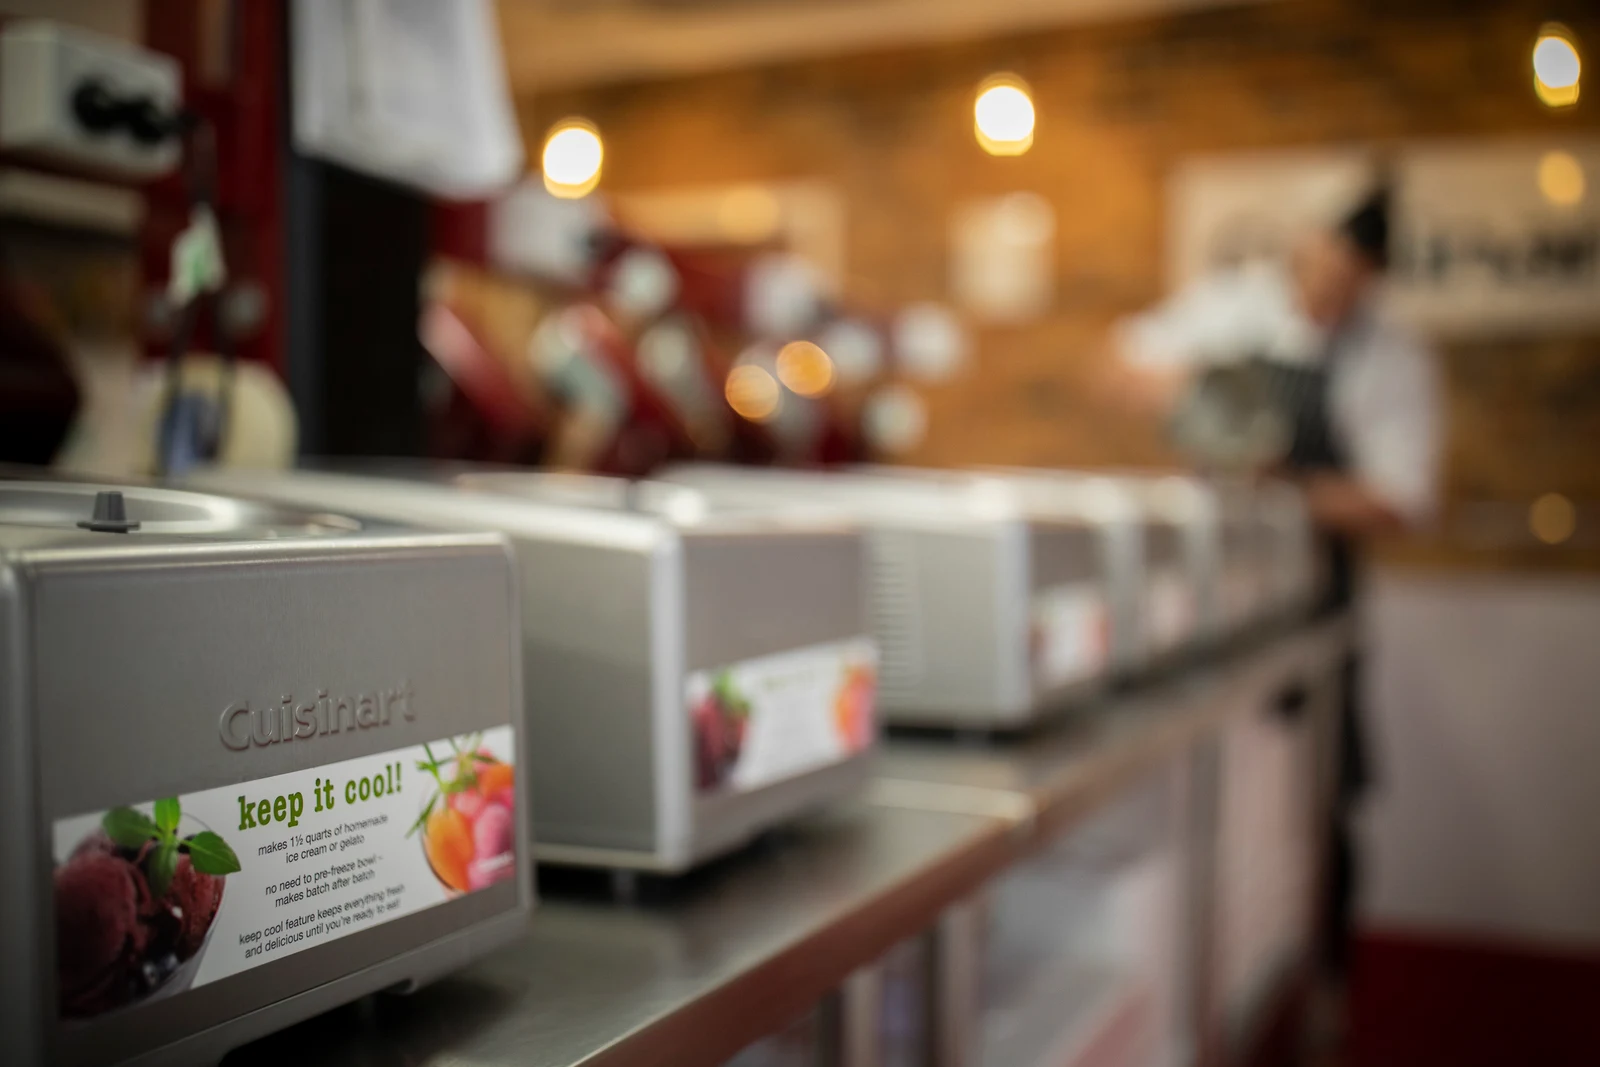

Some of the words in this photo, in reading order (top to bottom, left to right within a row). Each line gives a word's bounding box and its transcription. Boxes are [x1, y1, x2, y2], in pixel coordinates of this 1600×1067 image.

[219, 681, 415, 752] Cuisinart
[238, 792, 303, 830] keep
[314, 778, 335, 812] it
[345, 761, 401, 804] cool!
[258, 840, 288, 856] makes
[305, 828, 332, 846] quarts
[334, 823, 343, 836] of
[344, 814, 388, 832] homemade
[286, 852, 299, 863] ice
[301, 844, 327, 860] cream
[329, 841, 338, 851] or
[340, 834, 365, 851] gelato
[265, 884, 277, 895] no
[280, 875, 301, 891] need
[303, 874, 312, 884] to
[314, 861, 355, 883] pre-freeze
[275, 891, 304, 907] makes
[306, 882, 330, 898] batch
[331, 876, 351, 890] after
[352, 869, 376, 884] batch
[239, 930, 262, 945] keep
[264, 920, 283, 937] cool
[285, 913, 315, 930] feature
[317, 905, 342, 922] keeps
[344, 890, 385, 911] everything
[245, 943, 263, 959] and
[265, 931, 304, 952] delicious
[306, 922, 324, 939] until
[353, 908, 374, 923] ready
[377, 904, 385, 914] to
